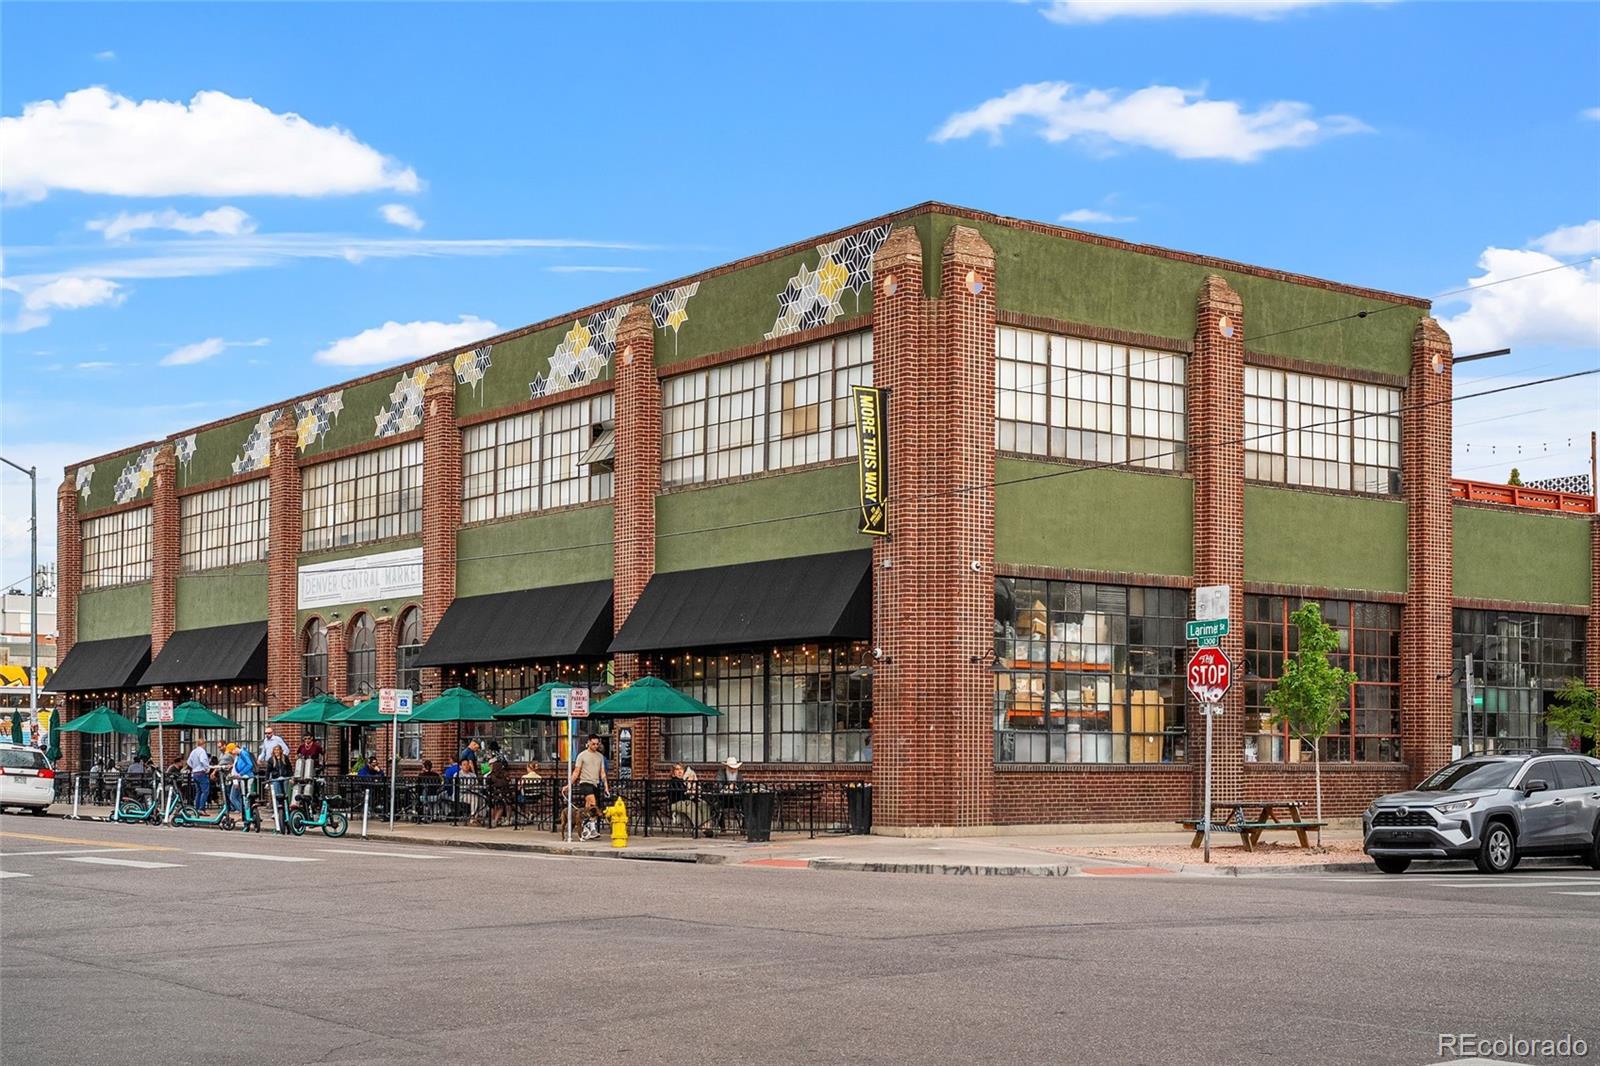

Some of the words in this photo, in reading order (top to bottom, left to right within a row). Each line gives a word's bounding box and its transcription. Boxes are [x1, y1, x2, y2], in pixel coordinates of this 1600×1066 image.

[860, 395, 875, 434] MORE
[863, 438, 877, 469] THIS
[864, 471, 877, 502] WAY
[305, 574, 337, 594] DENVER
[341, 569, 380, 590] CENTRAL
[1190, 624, 1218, 636] Larimer
[1190, 664, 1227, 685] STOP
